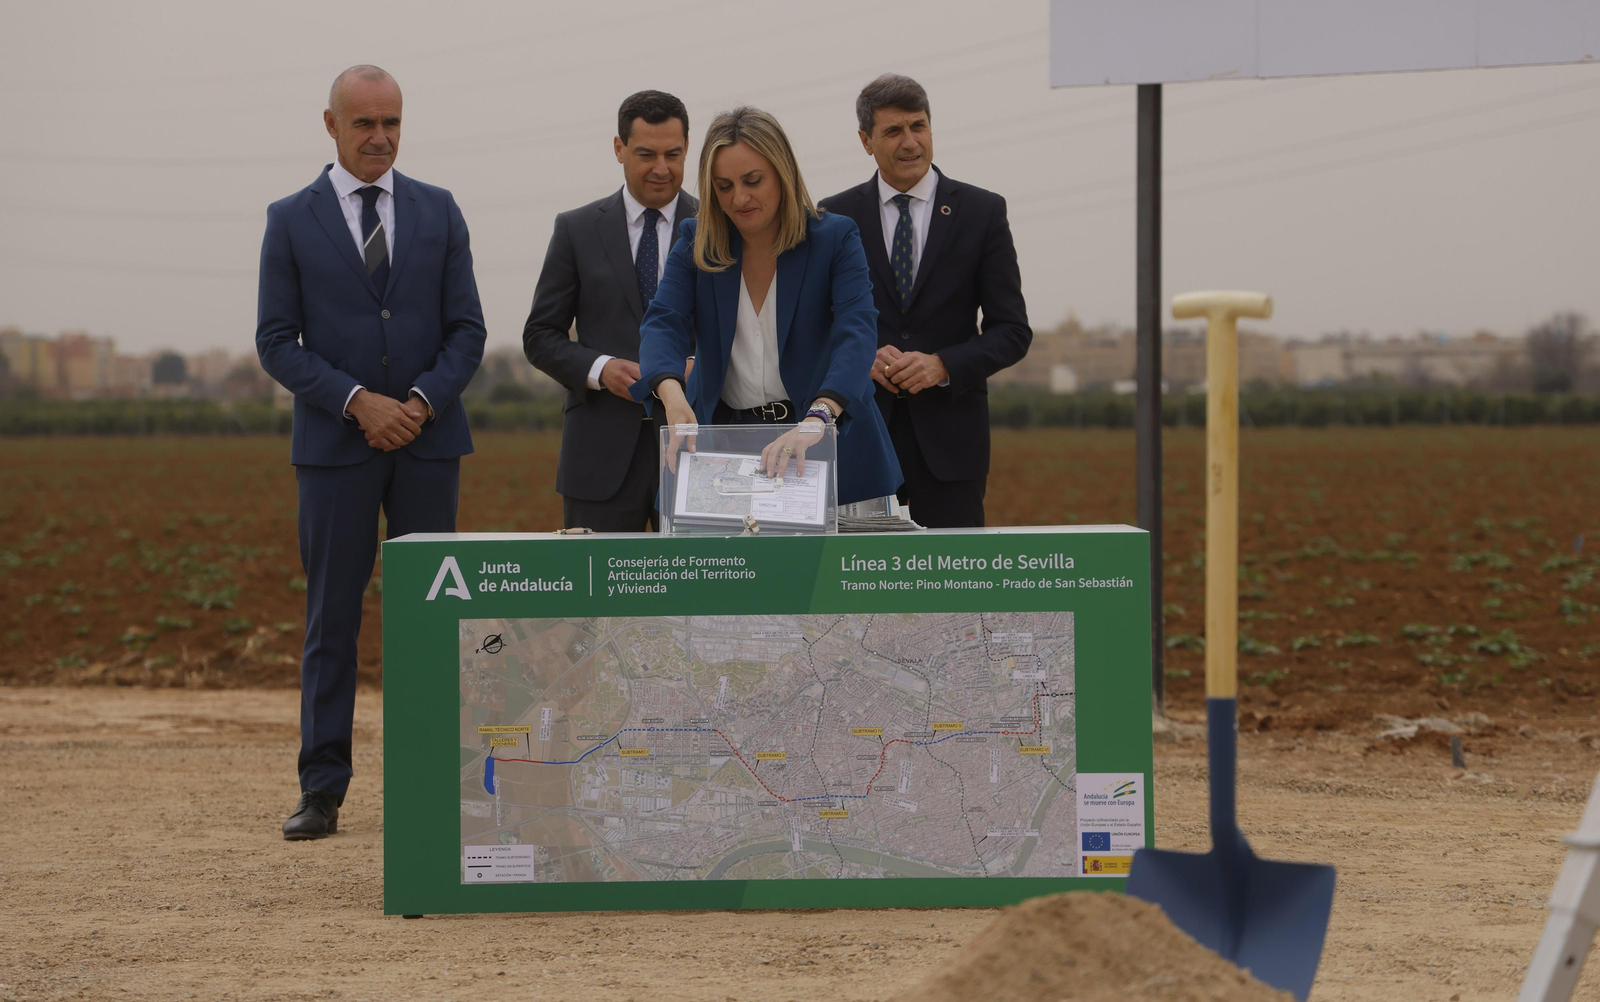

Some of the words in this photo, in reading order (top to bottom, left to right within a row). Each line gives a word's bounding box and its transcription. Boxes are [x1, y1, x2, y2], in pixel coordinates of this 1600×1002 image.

[479, 562, 520, 574] Junta
[608, 555, 668, 569] Consejería
[672, 556, 686, 566] de
[690, 556, 746, 566] Formento
[842, 554, 886, 571] Línea
[892, 556, 901, 570] 3
[906, 555, 932, 570] del
[938, 556, 987, 570] Metro
[992, 554, 1013, 569] de
[1018, 553, 1074, 570] Sevilla
[608, 568, 677, 580] Articulación
[681, 569, 698, 580] del
[701, 569, 756, 579] Territorio
[479, 579, 496, 592] de
[500, 576, 573, 591] Andalucía
[608, 586, 614, 596] y
[617, 583, 666, 593] Vivienda
[841, 581, 876, 590] Tramo
[879, 580, 913, 590] Norte:
[917, 579, 941, 589] Pino
[944, 580, 993, 589] Montano
[1003, 578, 1035, 588] Prado
[1038, 578, 1052, 588] de
[1055, 578, 1075, 588] San
[1079, 576, 1132, 588] Sebastián
